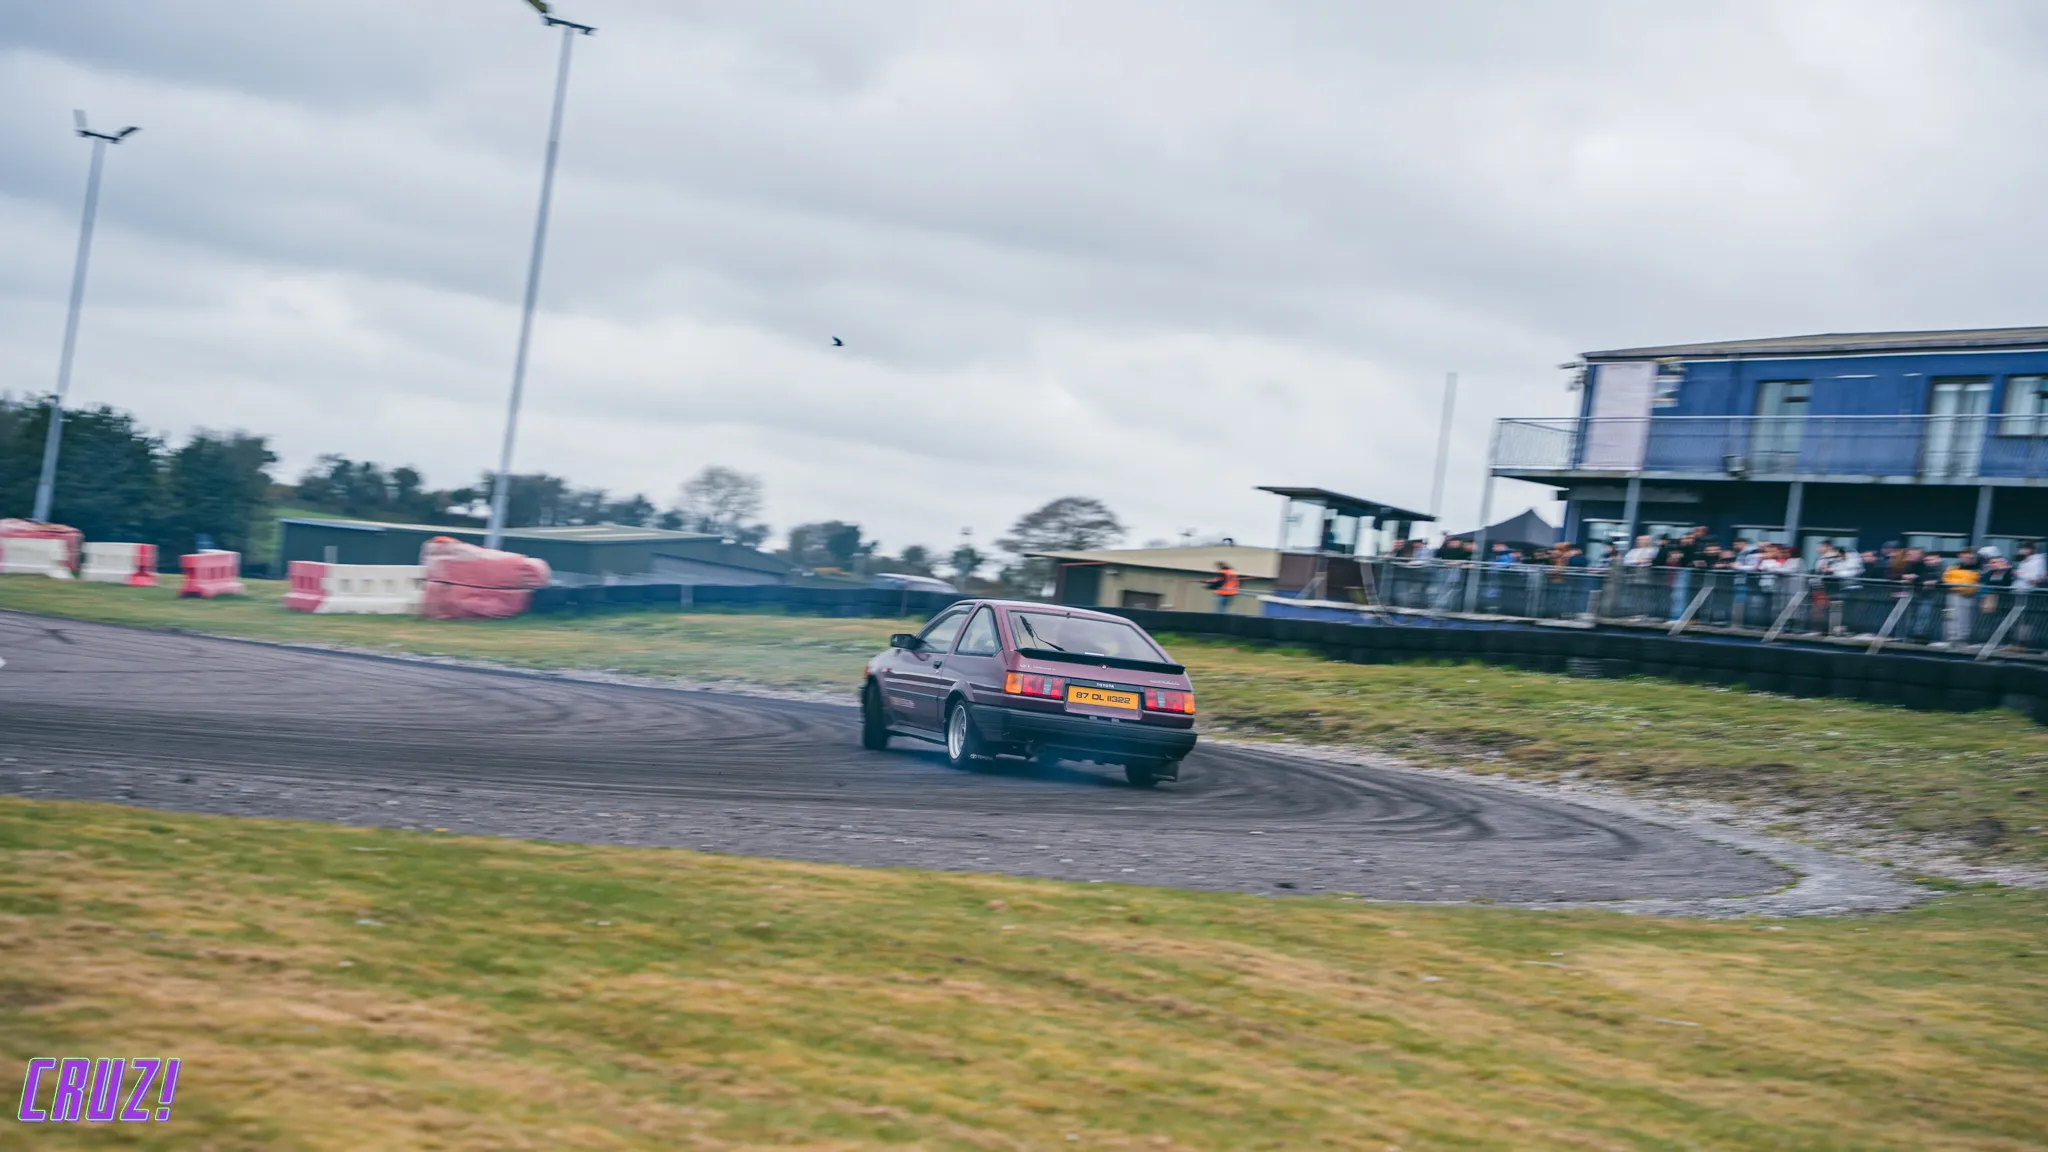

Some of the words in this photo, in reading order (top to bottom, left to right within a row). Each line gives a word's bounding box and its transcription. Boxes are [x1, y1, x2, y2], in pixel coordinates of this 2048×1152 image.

[1076, 691, 1089, 699] 87
[1091, 693, 1105, 701] DL
[1107, 695, 1131, 704] 11322
